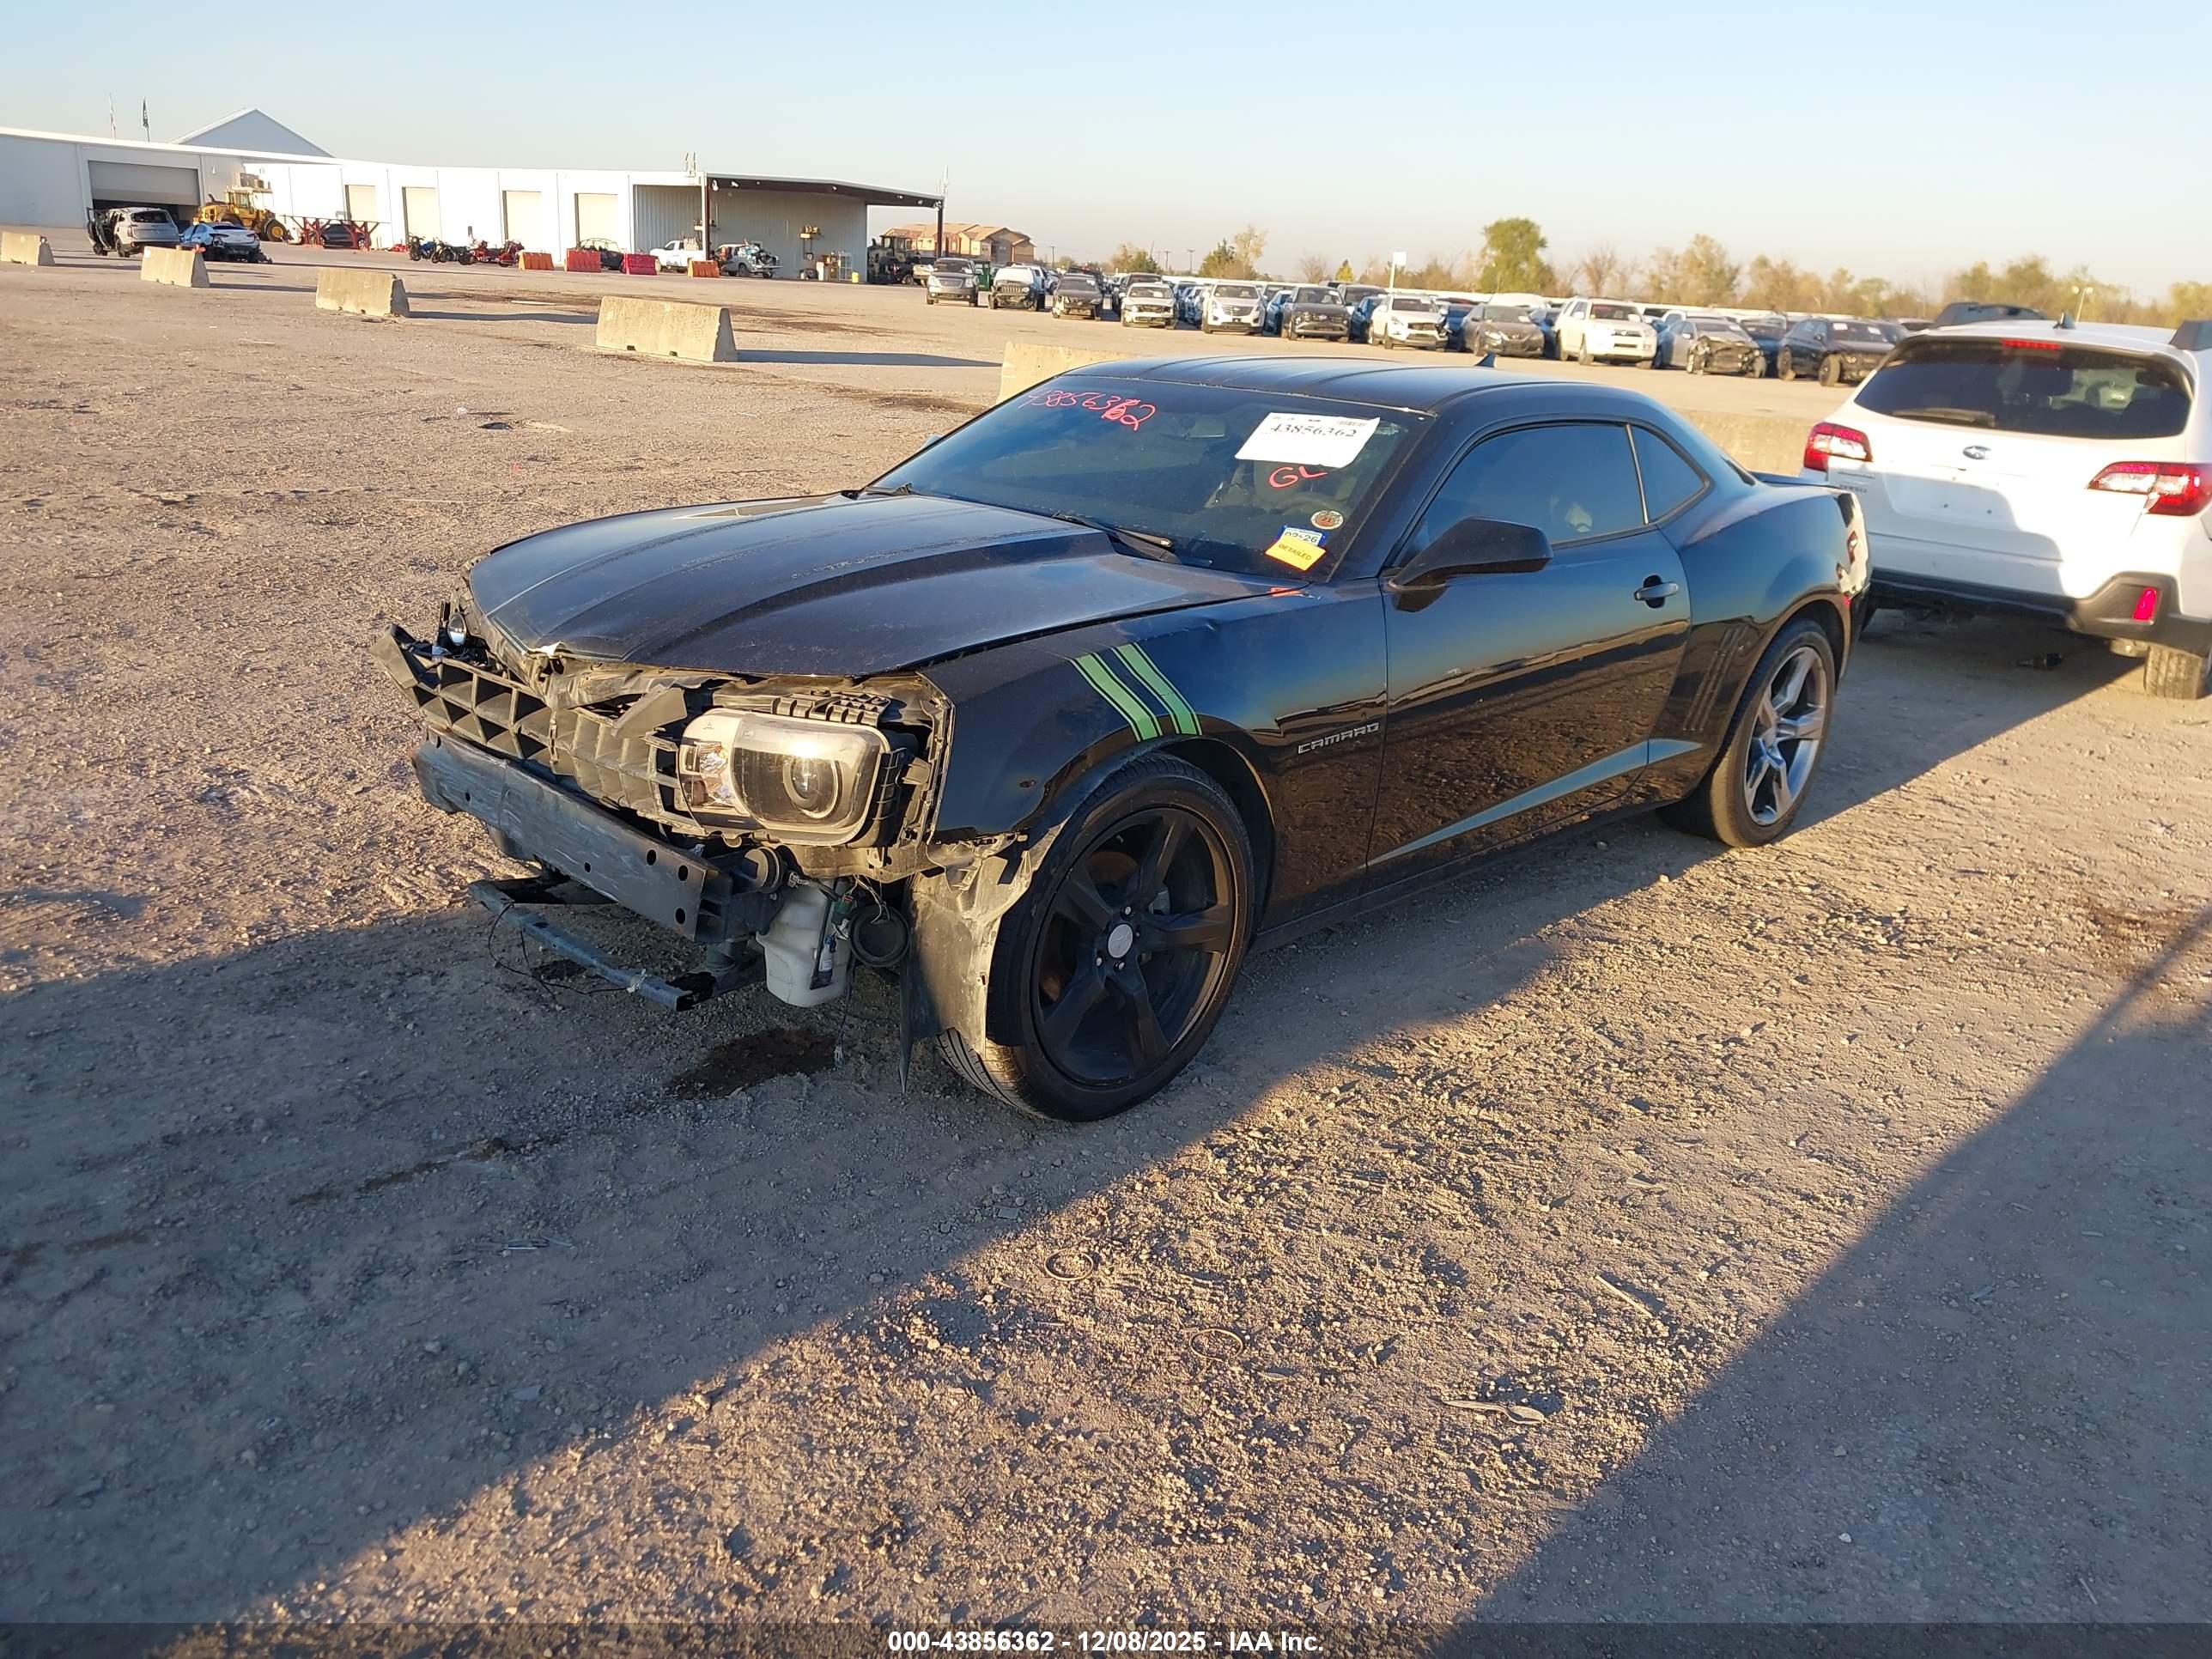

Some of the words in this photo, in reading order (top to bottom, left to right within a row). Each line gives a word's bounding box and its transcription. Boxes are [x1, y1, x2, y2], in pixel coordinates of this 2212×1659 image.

[1271, 423, 1357, 437] 43856362
[1279, 544, 1312, 561] DETAILED
[1298, 723, 1379, 754] CAMARO
